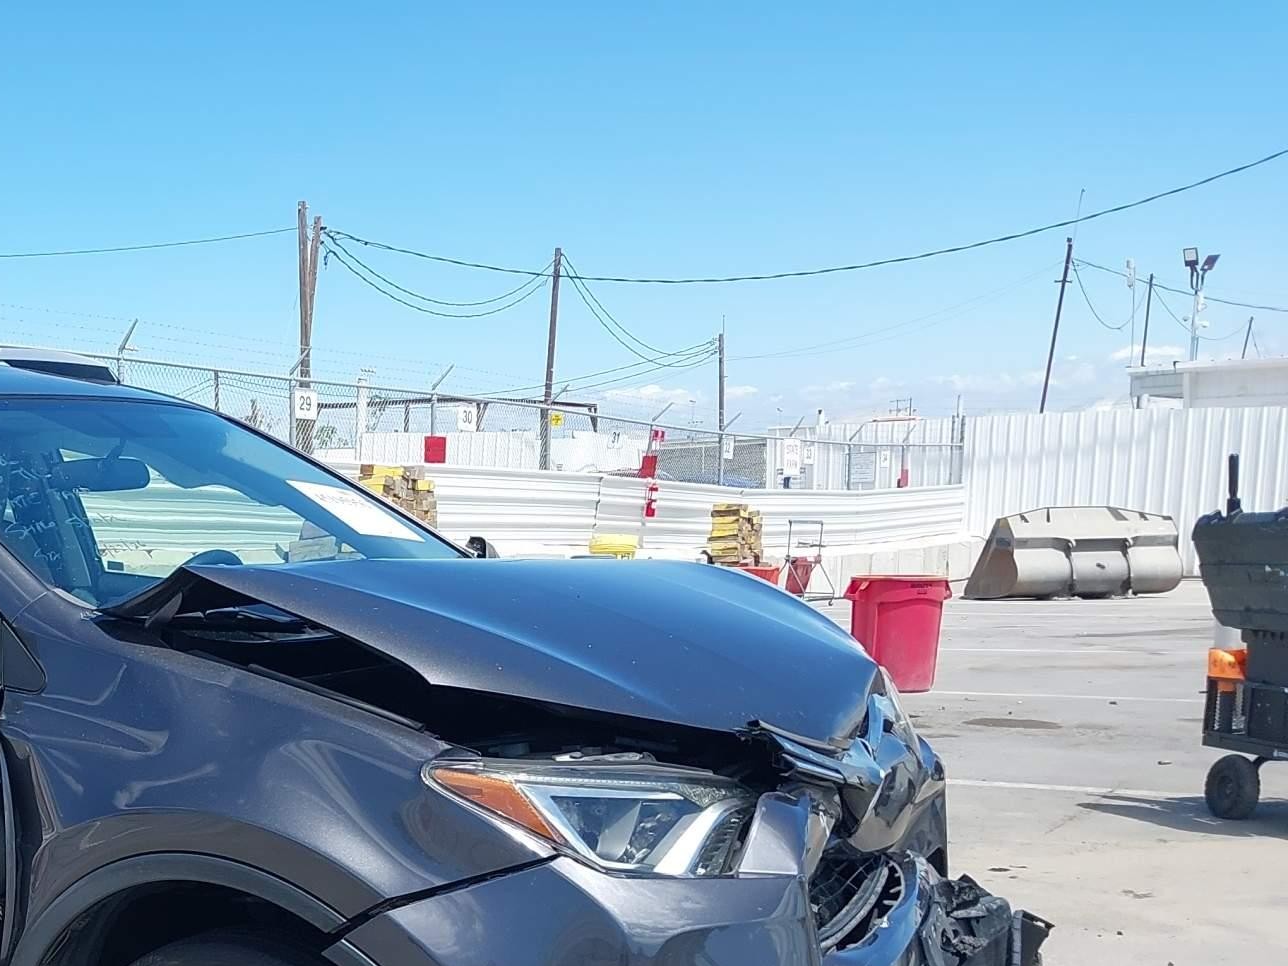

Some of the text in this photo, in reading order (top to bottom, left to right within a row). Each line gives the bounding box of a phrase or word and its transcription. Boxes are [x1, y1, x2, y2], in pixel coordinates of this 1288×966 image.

[299, 395, 311, 411] 29
[462, 410, 472, 424] 30
[612, 431, 621, 444] 31
